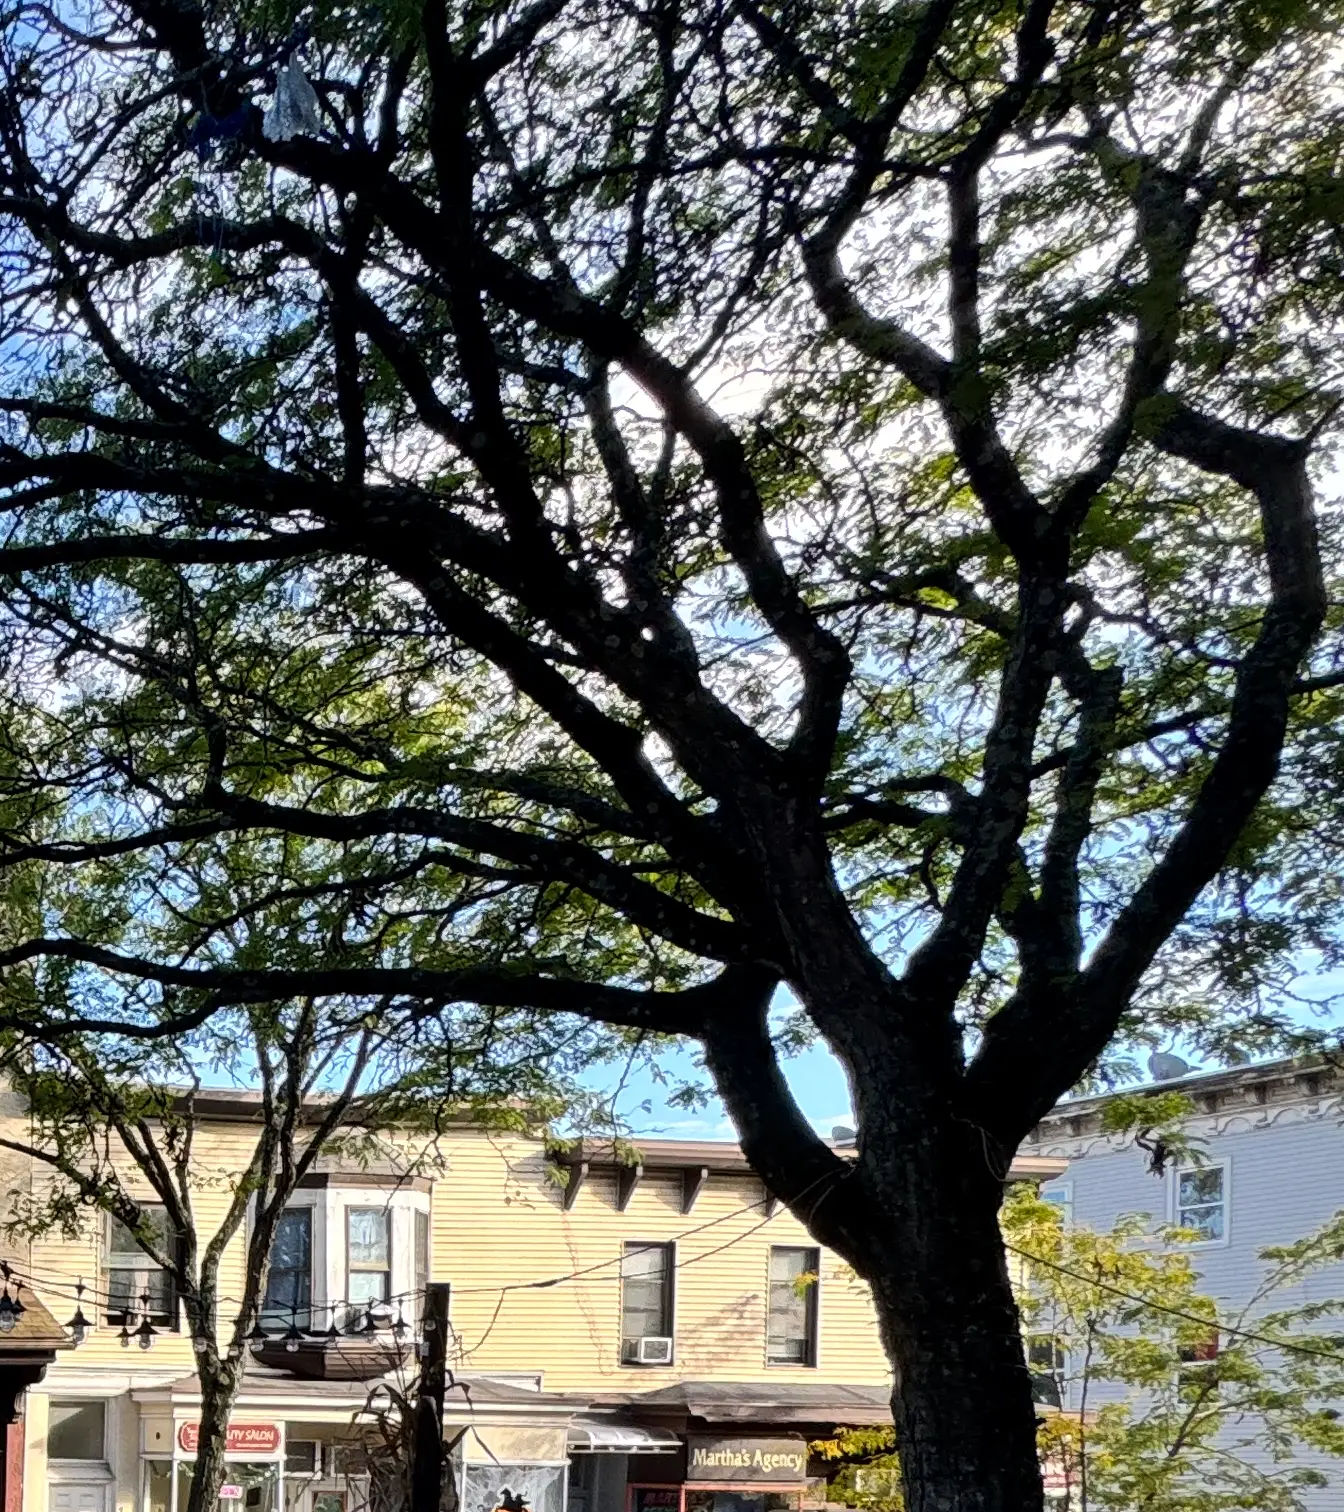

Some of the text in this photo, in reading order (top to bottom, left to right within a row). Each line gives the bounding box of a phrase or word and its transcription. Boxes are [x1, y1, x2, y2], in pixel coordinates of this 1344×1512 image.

[245, 1429, 274, 1441] SALON
[692, 1448, 803, 1473] Martha's Agency
